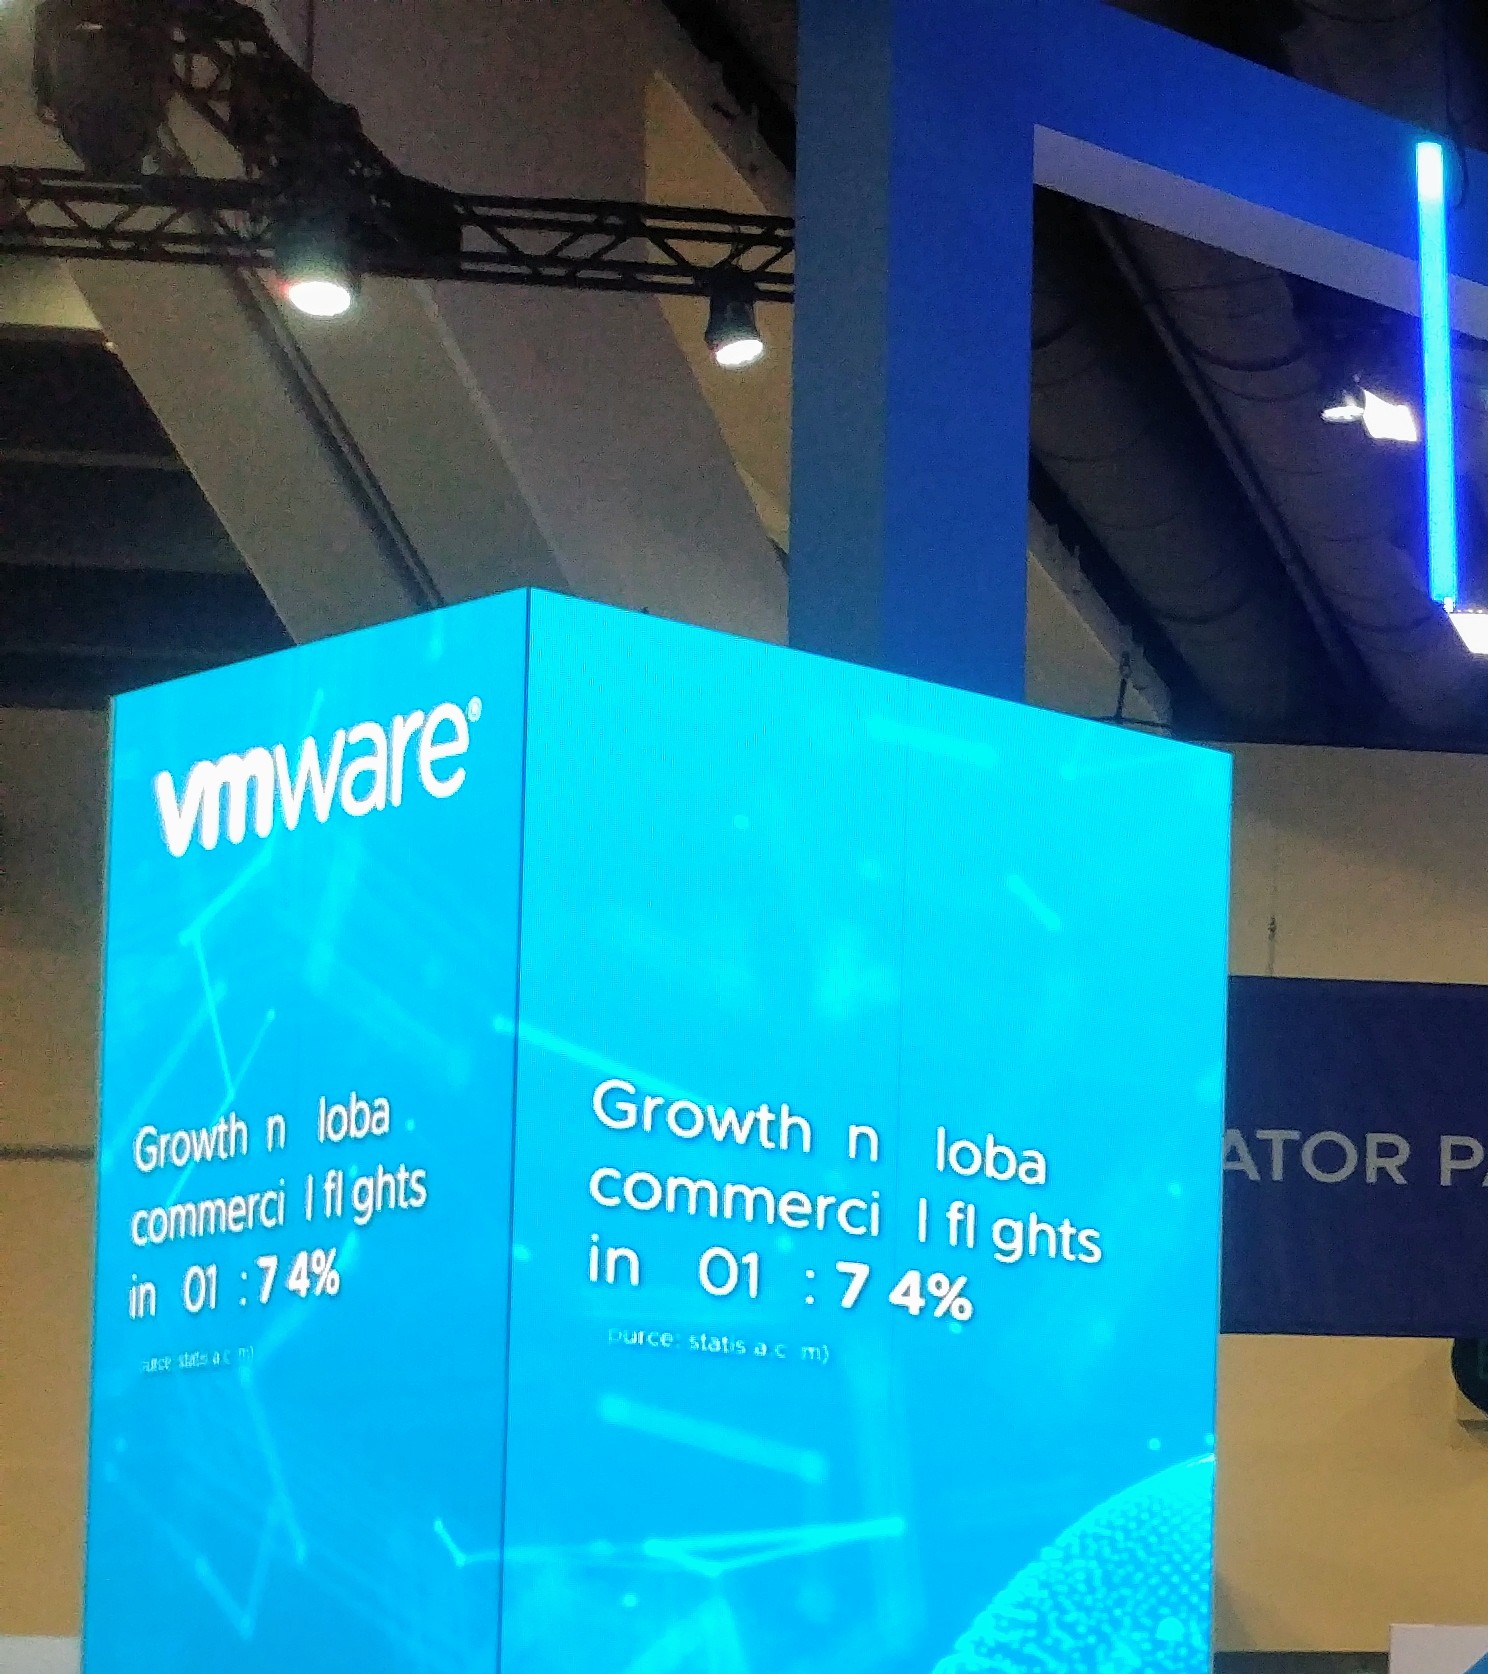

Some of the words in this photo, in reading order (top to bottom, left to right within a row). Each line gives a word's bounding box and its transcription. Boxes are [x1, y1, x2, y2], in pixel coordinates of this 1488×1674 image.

[133, 1112, 248, 1172] Growth
[592, 1078, 811, 1153] Growth
[1222, 1129, 1411, 1185] ATOR
[589, 1233, 640, 1286] in
[129, 1274, 156, 1319] in
